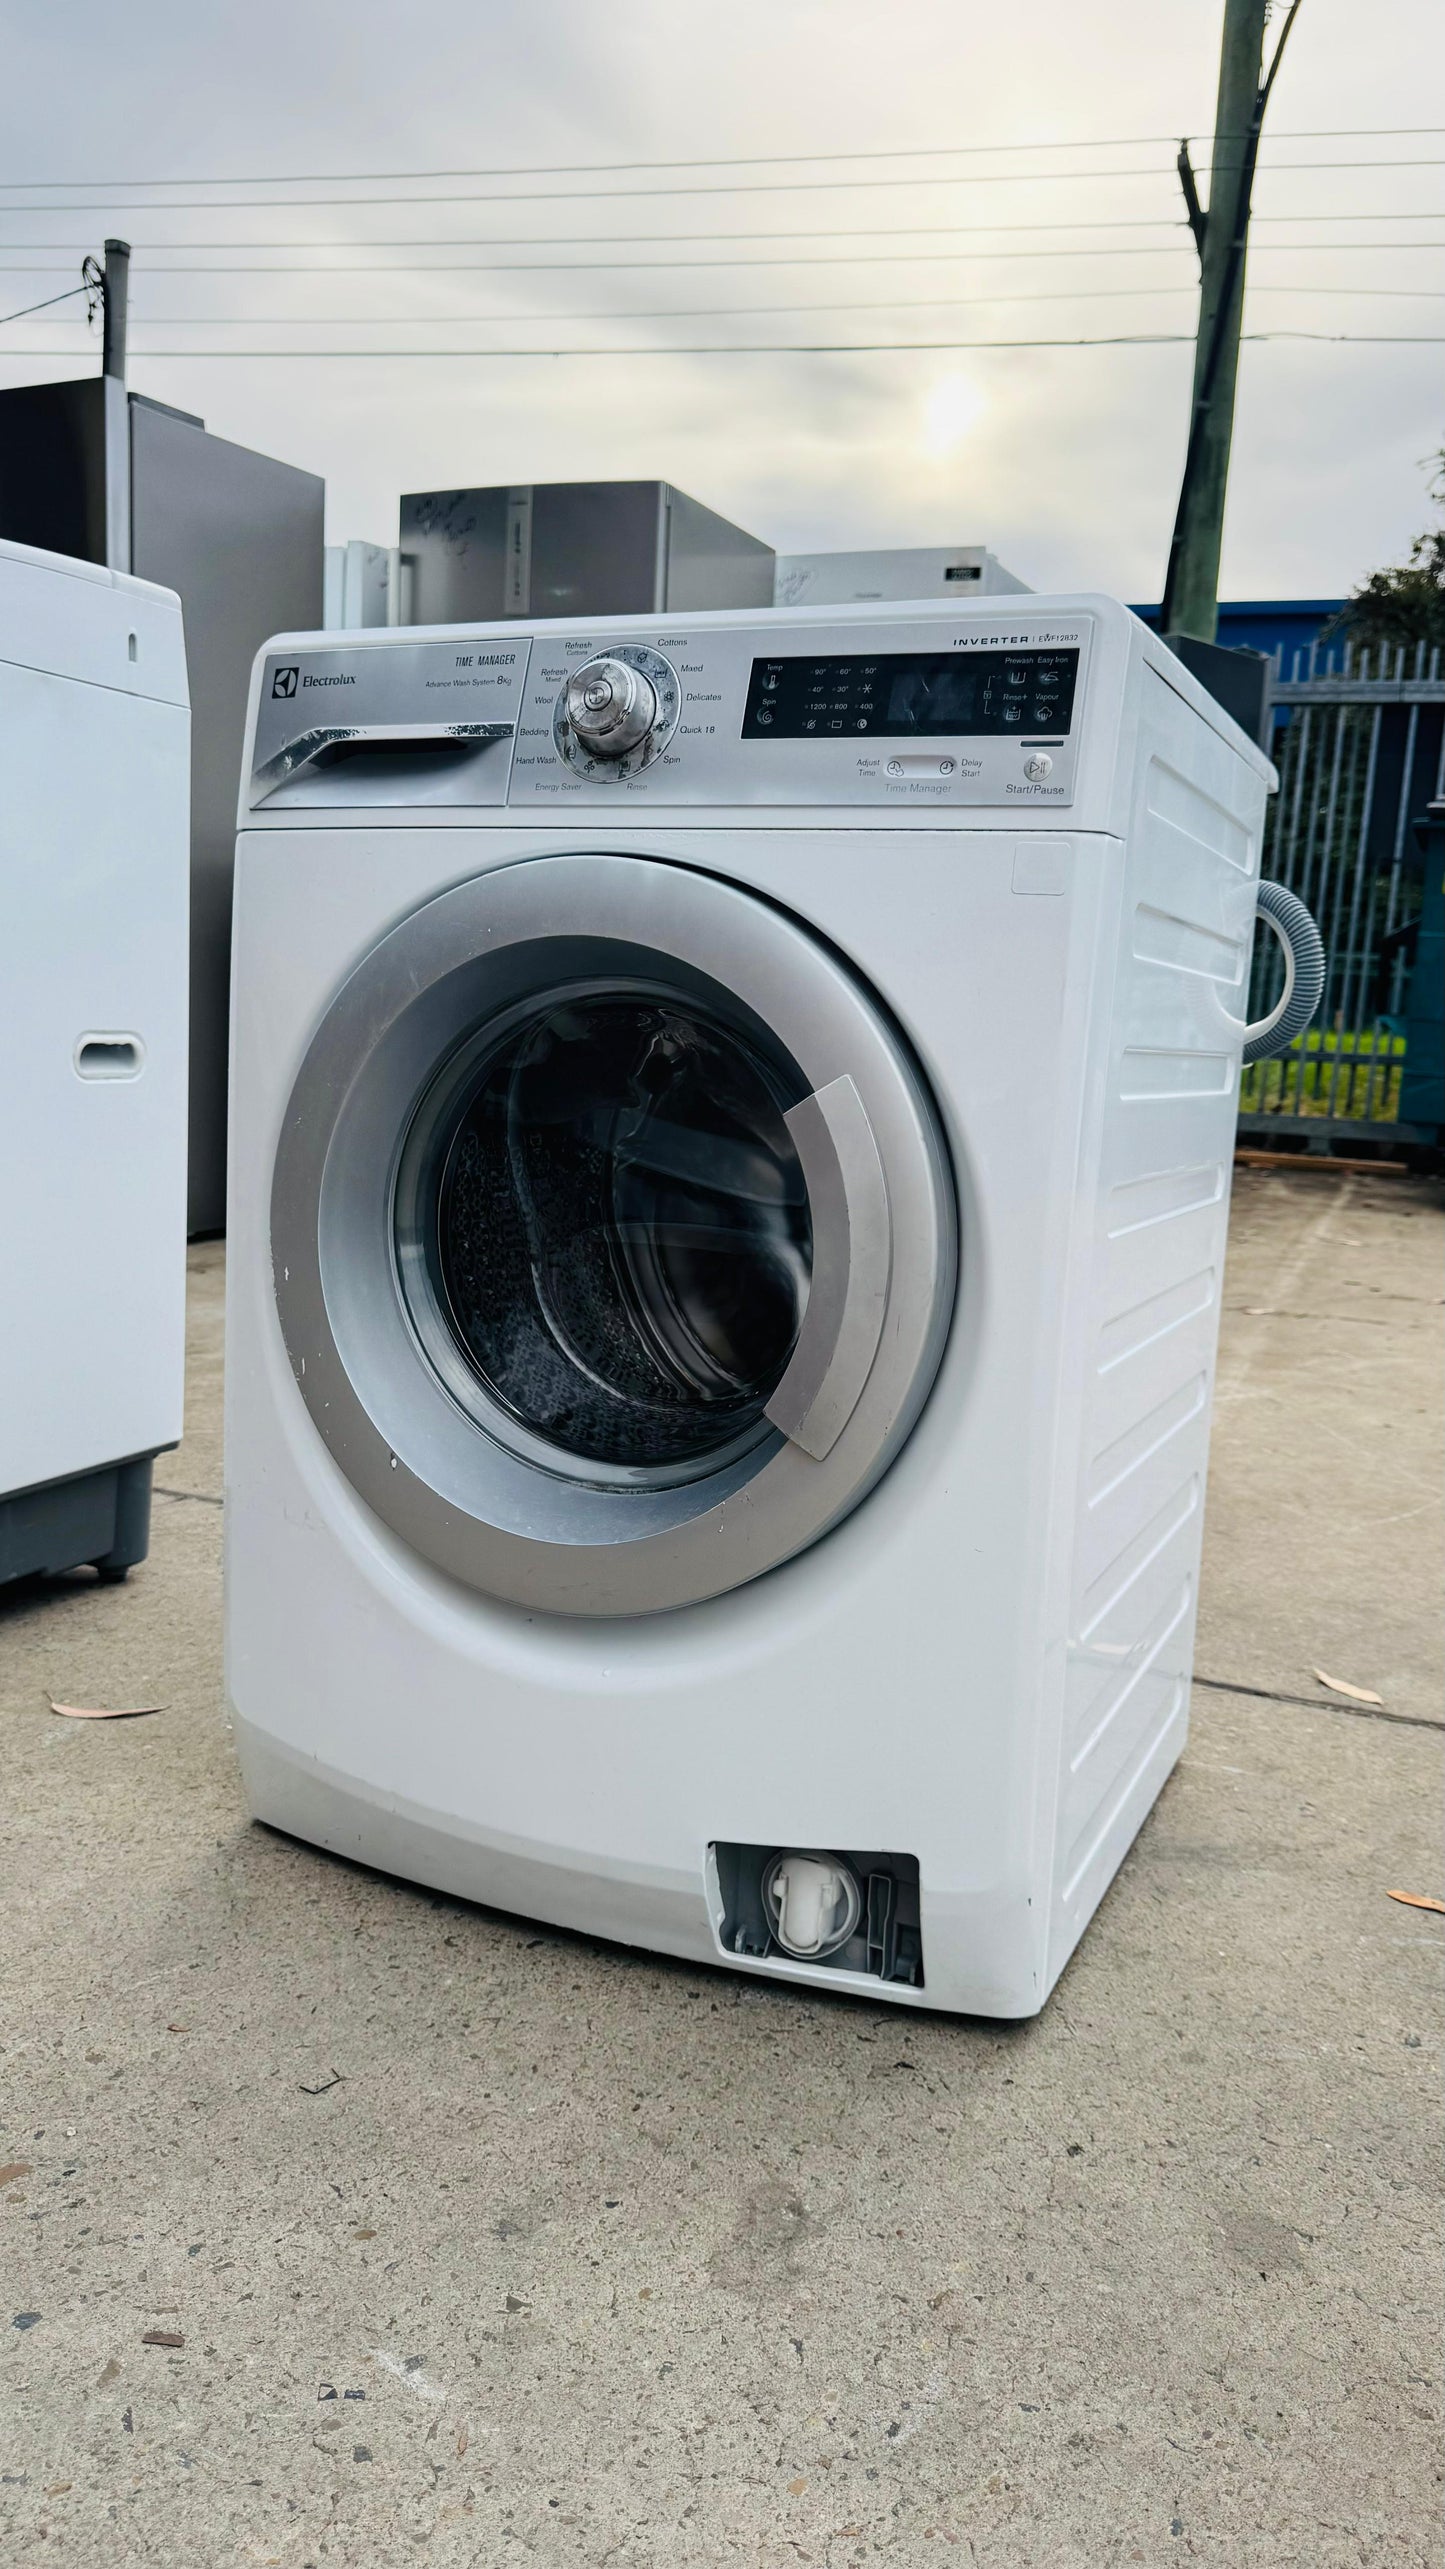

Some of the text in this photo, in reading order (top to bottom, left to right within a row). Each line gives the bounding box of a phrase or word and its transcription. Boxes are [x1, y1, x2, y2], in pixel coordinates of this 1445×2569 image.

[565, 641, 592, 650] Refresh
[658, 638, 688, 647] Cottons
[953, 636, 1029, 646] INVERTER
[455, 654, 516, 667] TIME MANAGER
[1037, 656, 1054, 666] Easy
[541, 668, 568, 676] Refresh
[681, 664, 704, 672] Mixed
[767, 664, 783, 672] Temp
[303, 673, 356, 688] Electrolux
[472, 678, 496, 688] System
[535, 696, 554, 704] Wool
[686, 693, 722, 701] Delicates
[1035, 693, 1060, 702] Vapour
[762, 698, 777, 706] Spin
[520, 728, 550, 737] Bedding
[680, 725, 702, 734] Quick
[663, 756, 681, 765] Spin
[856, 758, 880, 768] Adjust
[961, 758, 983, 768] Delay
[859, 769, 876, 777] Time
[961, 769, 981, 777] Start
[535, 783, 582, 792] Energy Saver
[627, 783, 648, 791] Rinse
[884, 783, 952, 795] Time Manager
[1005, 784, 1065, 795] Start/Pause
